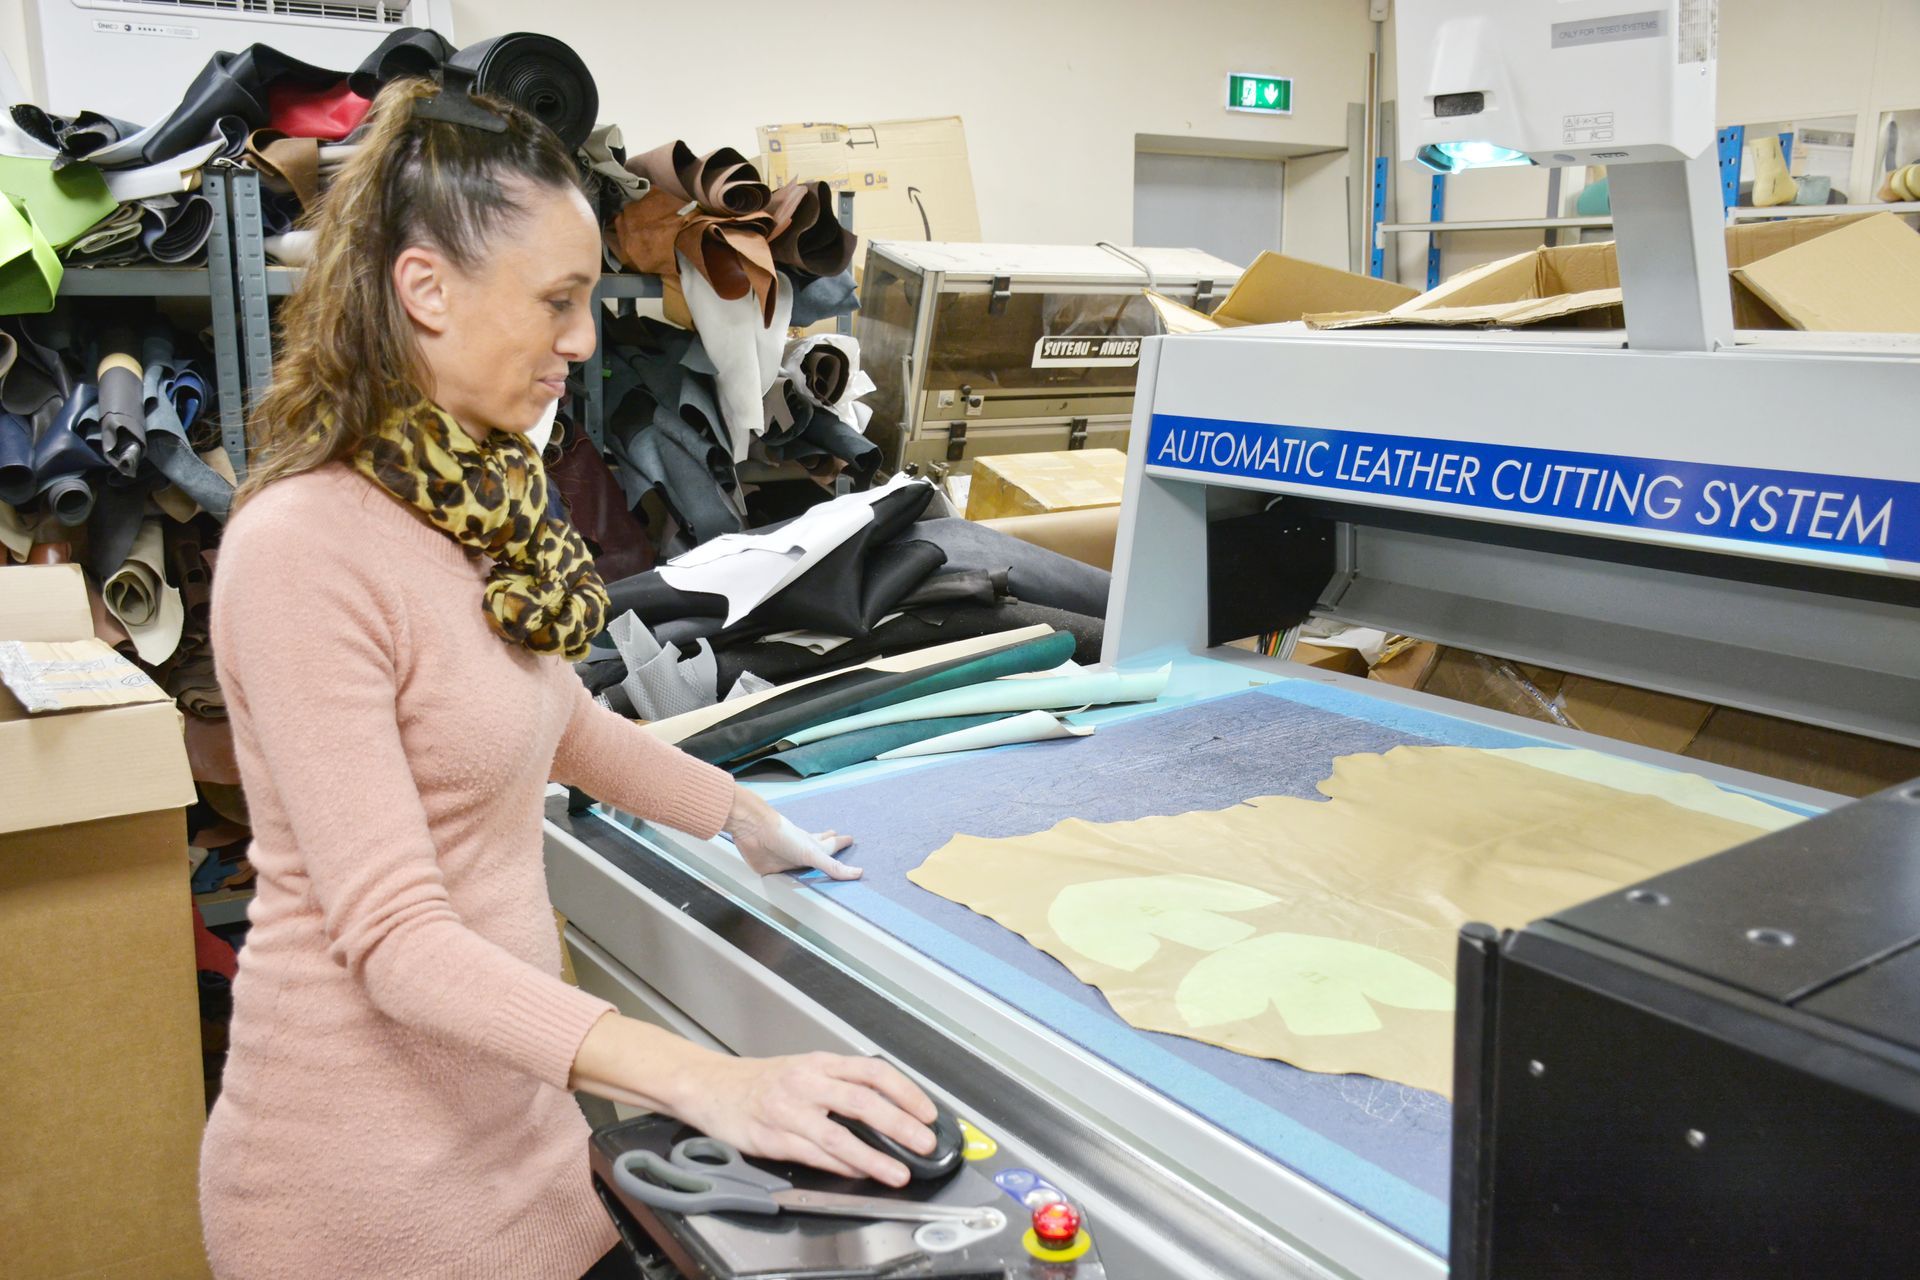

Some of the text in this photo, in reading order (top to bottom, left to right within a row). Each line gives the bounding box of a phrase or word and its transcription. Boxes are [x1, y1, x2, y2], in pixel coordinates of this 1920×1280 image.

[1559, 30, 1577, 39] ONLY
[1579, 27, 1595, 36] FOR
[1622, 20, 1658, 32] SYSTEMS
[1043, 341, 1091, 355] SUTEAU
[1099, 341, 1140, 355] ANVER
[1157, 428, 1894, 546] AUTOMATIC LEATHER CUTTING SYSTEM
